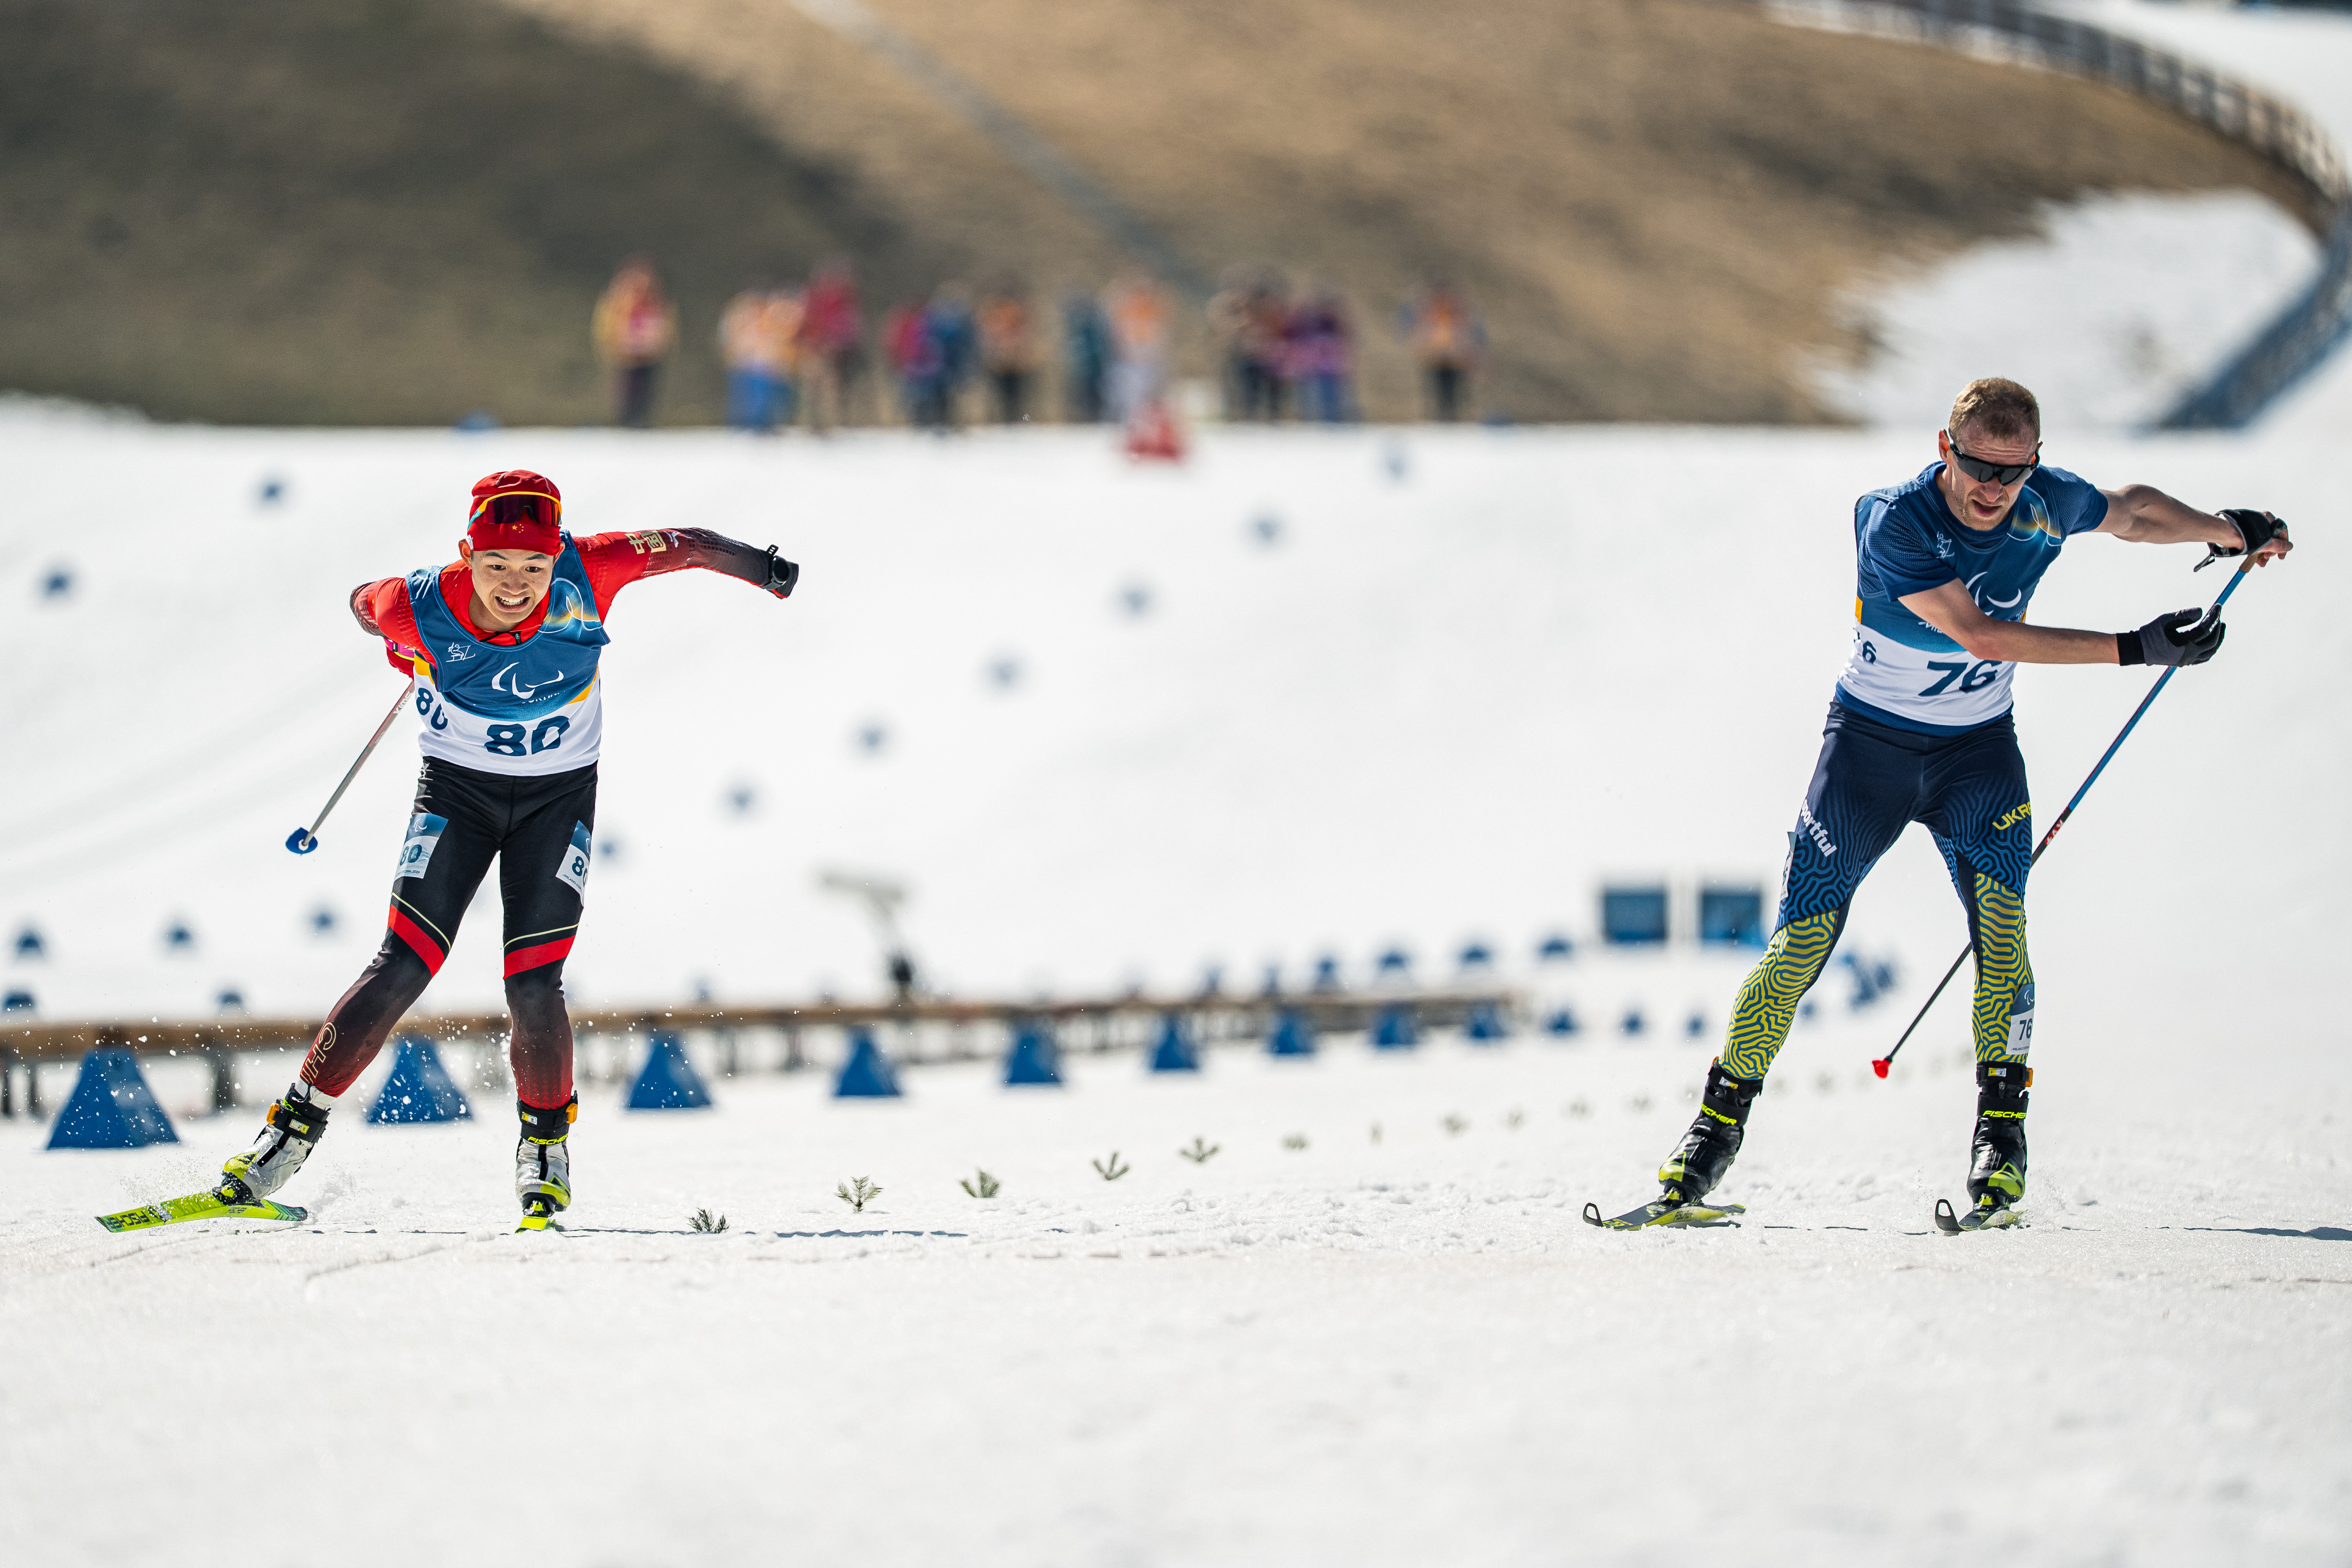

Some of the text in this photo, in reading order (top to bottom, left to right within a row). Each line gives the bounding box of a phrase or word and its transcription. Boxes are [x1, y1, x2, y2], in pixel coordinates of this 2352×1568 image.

[1918, 660, 2002, 697] 76
[483, 715, 570, 757] 80
[399, 844, 423, 866] 80
[2018, 1018, 2033, 1041] 76
